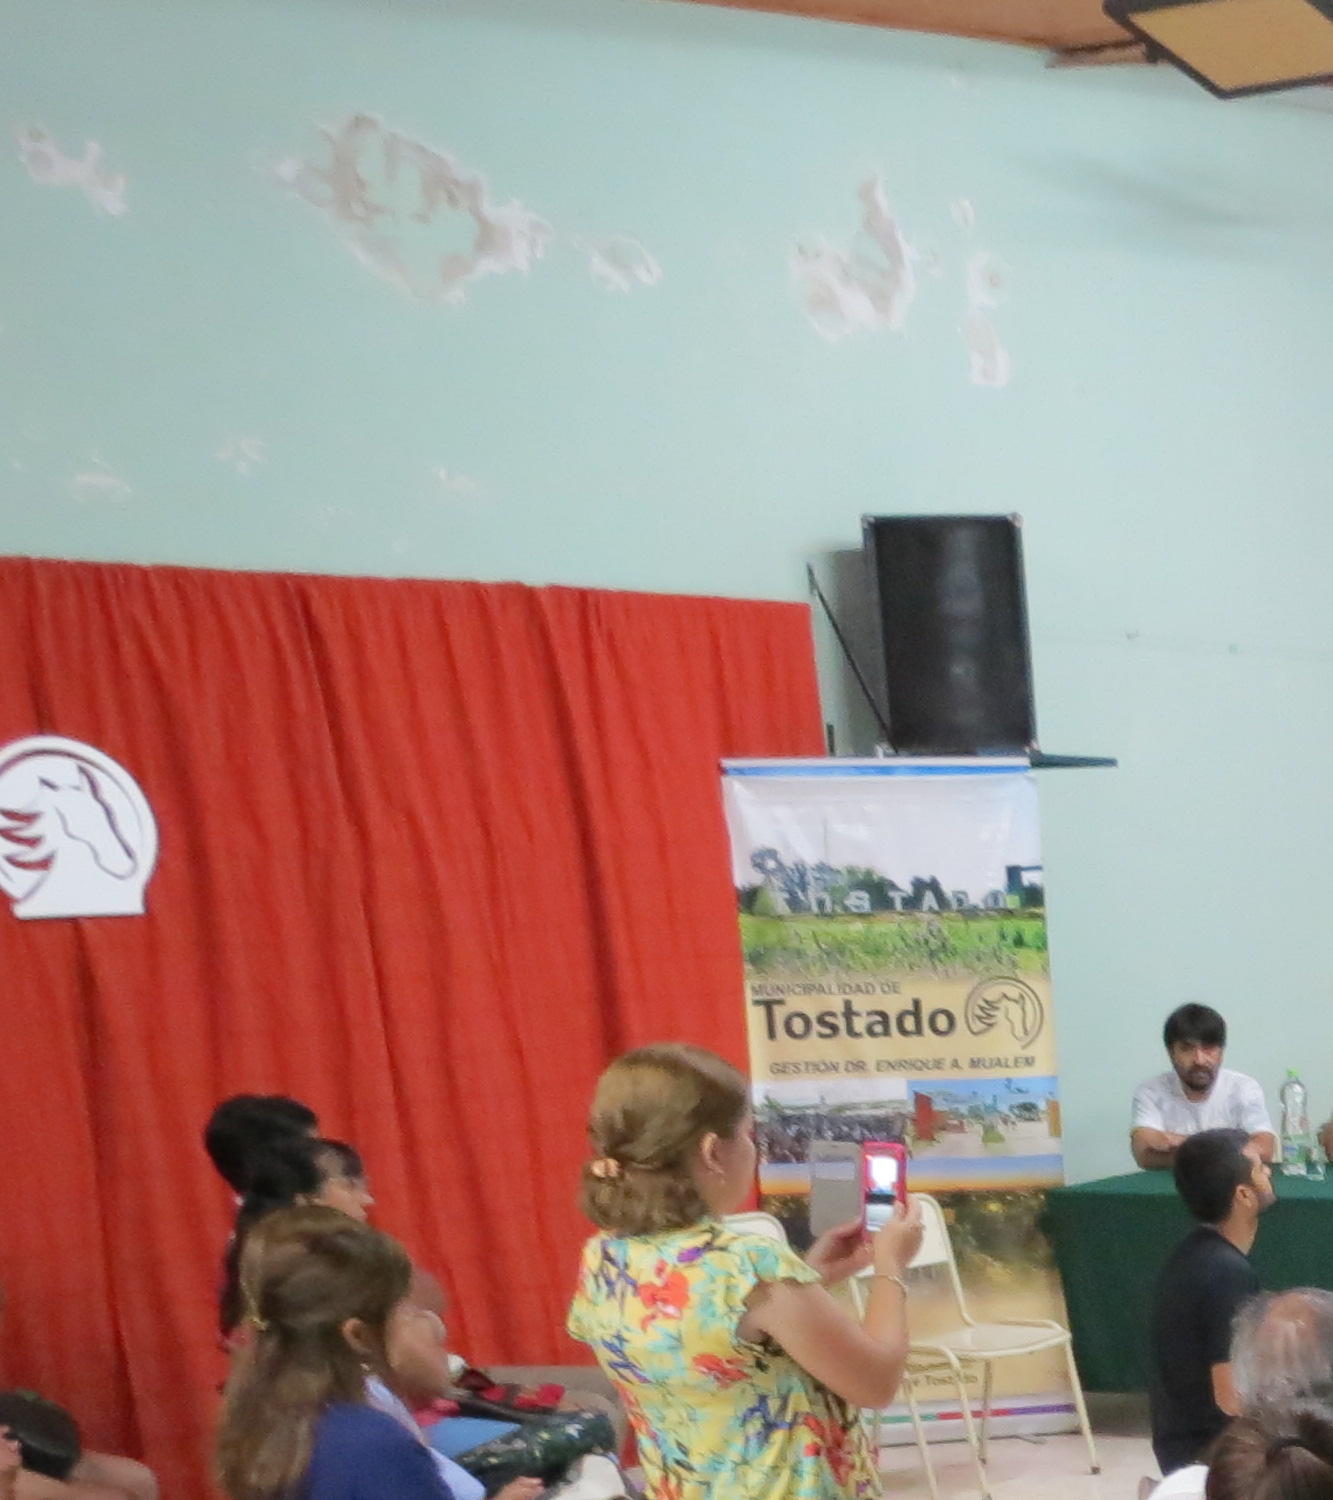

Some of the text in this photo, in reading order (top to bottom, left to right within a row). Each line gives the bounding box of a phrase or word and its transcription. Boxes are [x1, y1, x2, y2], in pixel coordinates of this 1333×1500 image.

[751, 980, 902, 997] MUNICIPALIDAD DE
[753, 997, 958, 1041] Tostado
[876, 1057, 946, 1073] ENRIQUE
[967, 1055, 1036, 1070] MUALEM
